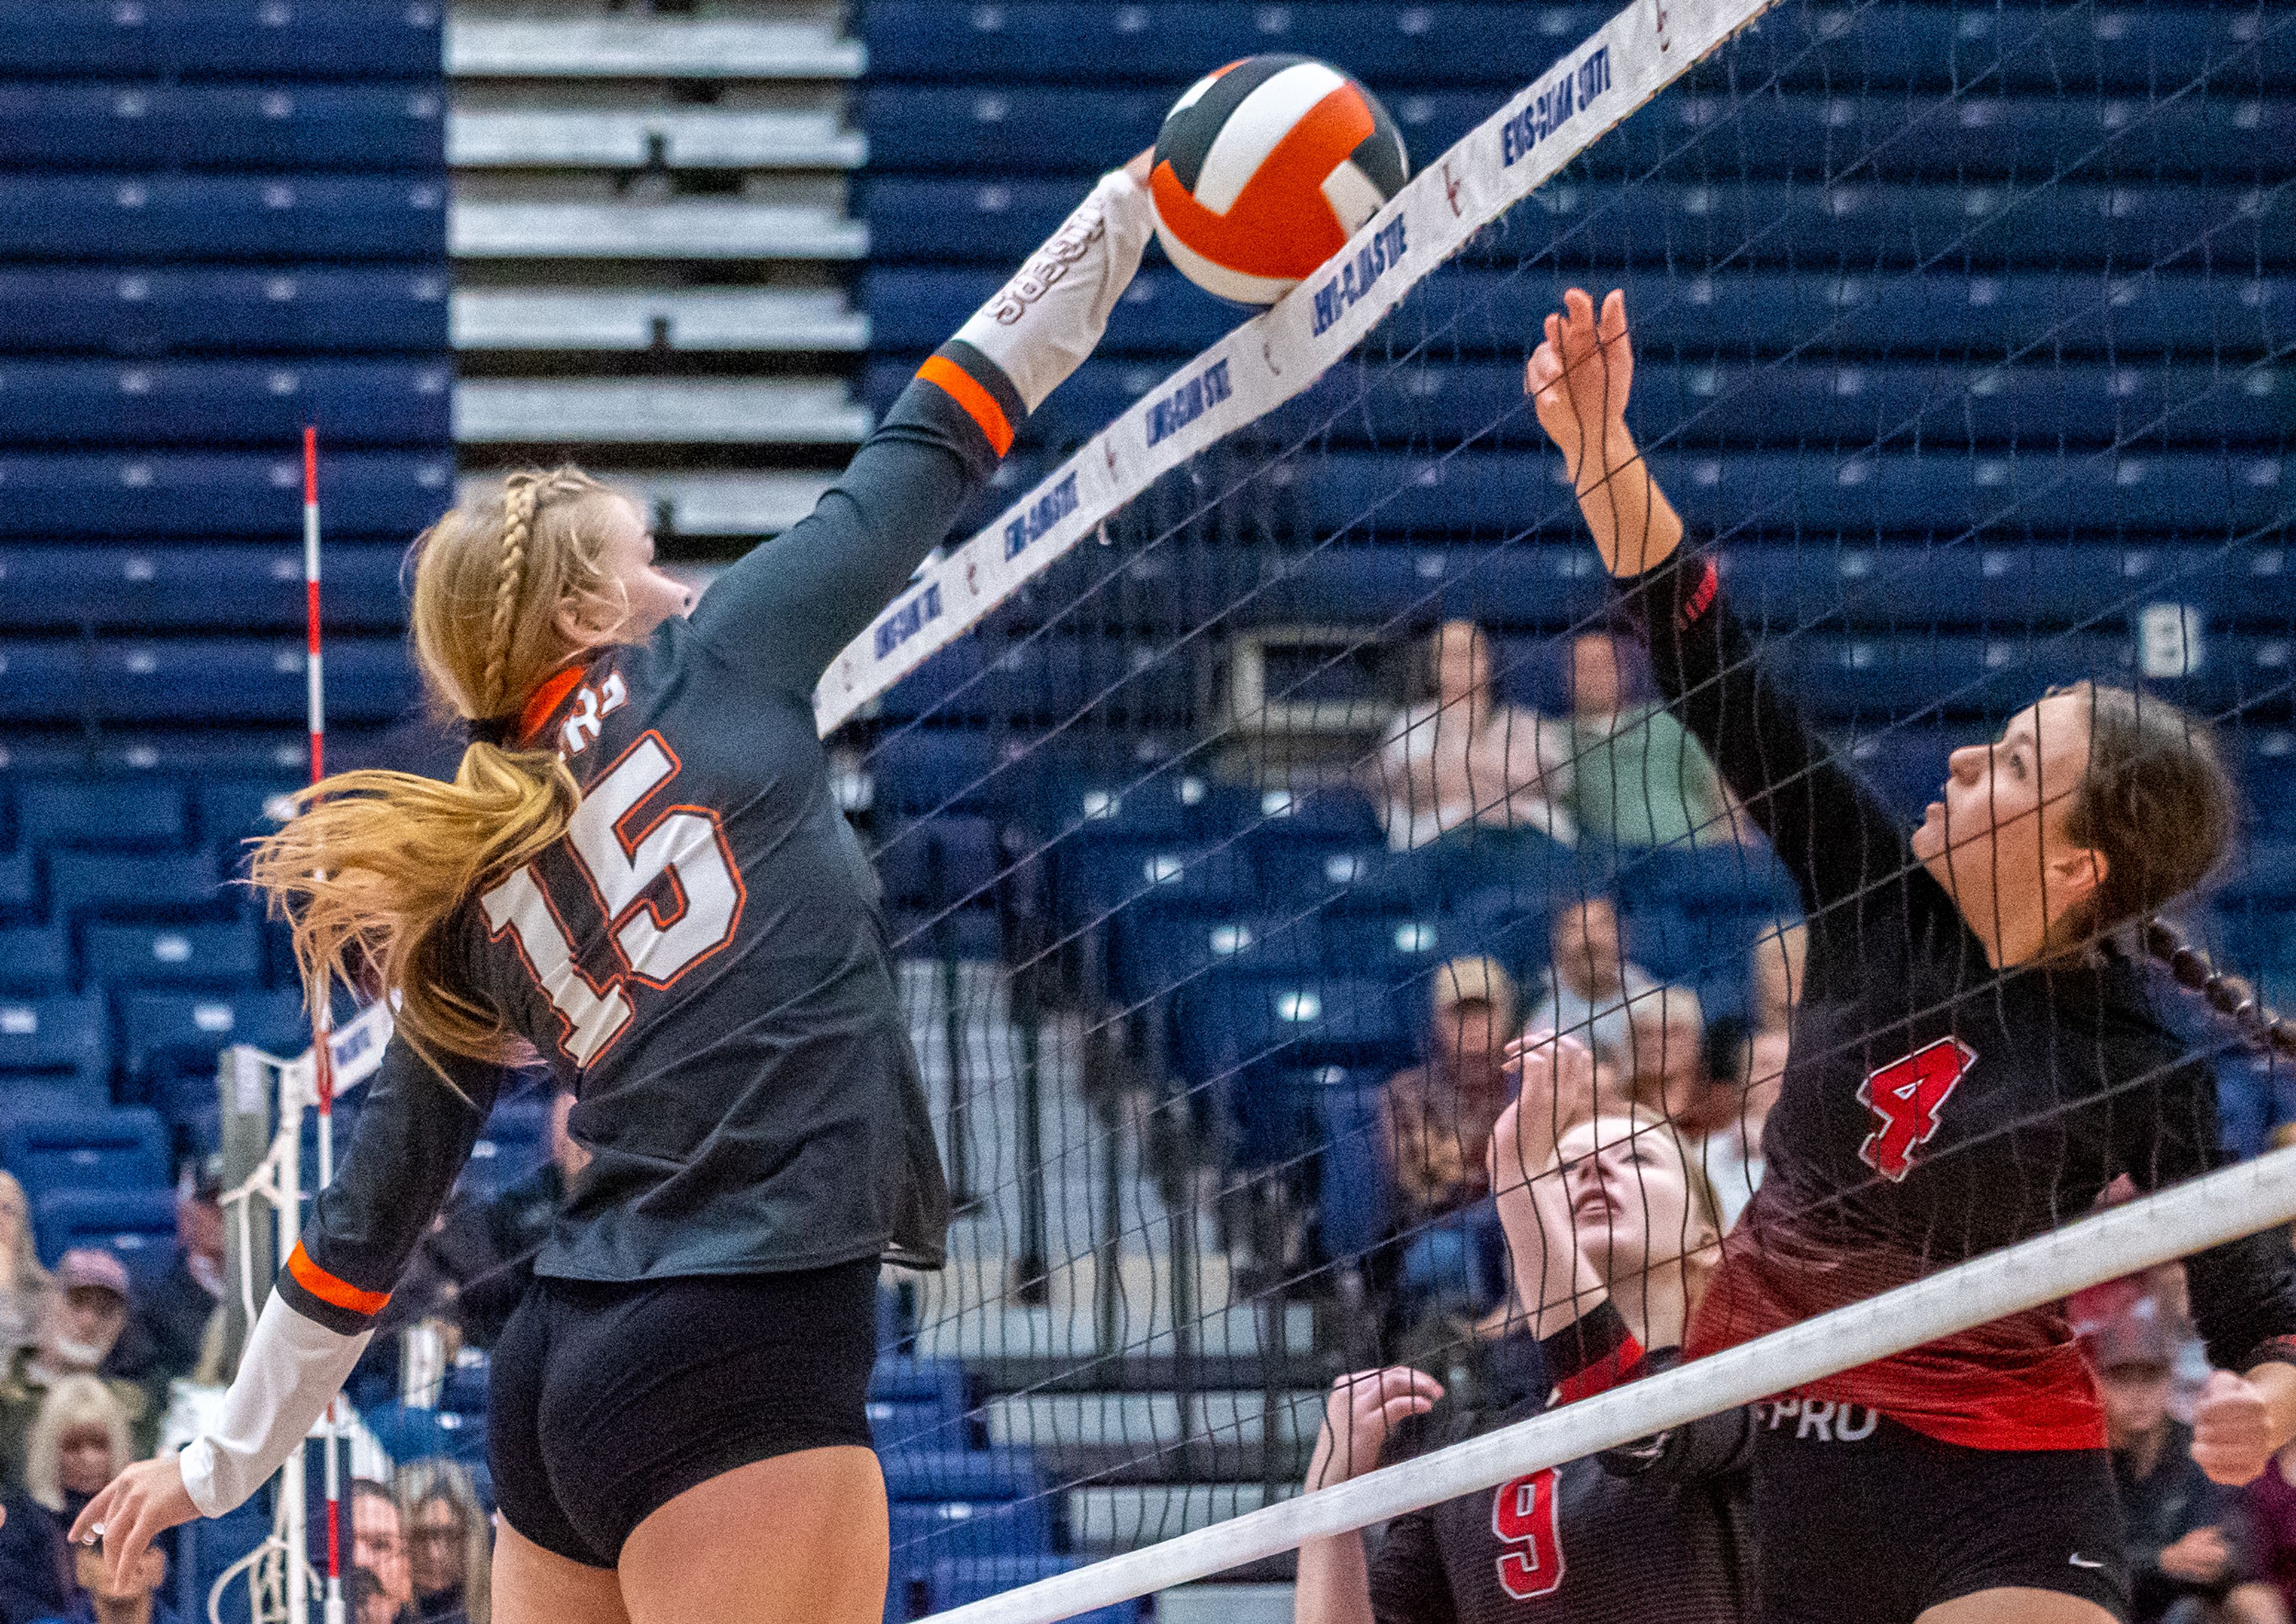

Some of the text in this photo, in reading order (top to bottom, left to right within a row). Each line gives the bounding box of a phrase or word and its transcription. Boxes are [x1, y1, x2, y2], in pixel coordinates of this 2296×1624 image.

[478, 729, 746, 1070] 15
[1856, 1035, 1979, 1183] 4
[1492, 1467, 1565, 1599] 9
